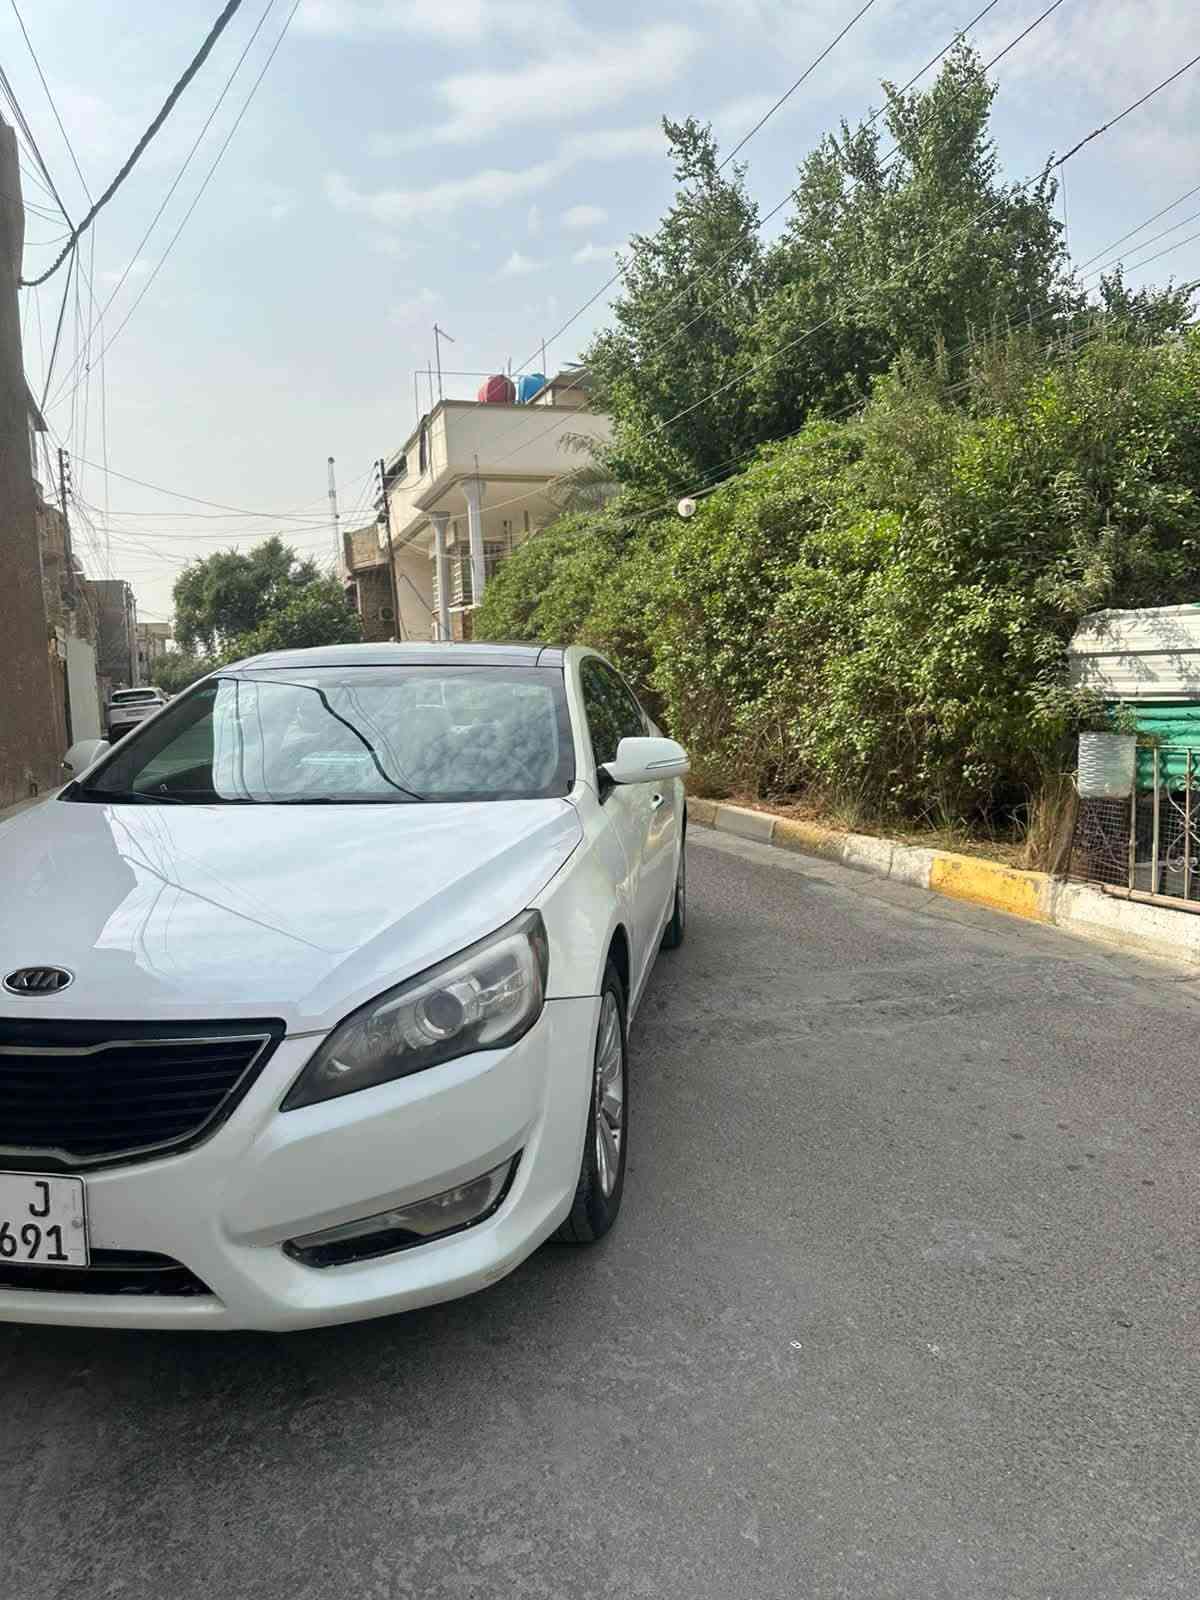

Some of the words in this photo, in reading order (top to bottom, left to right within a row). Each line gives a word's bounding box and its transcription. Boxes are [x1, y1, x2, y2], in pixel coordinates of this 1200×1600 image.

[14, 971, 60, 987] KIA
[29, 1181, 50, 1217] J
[0, 1221, 69, 1261] 691
